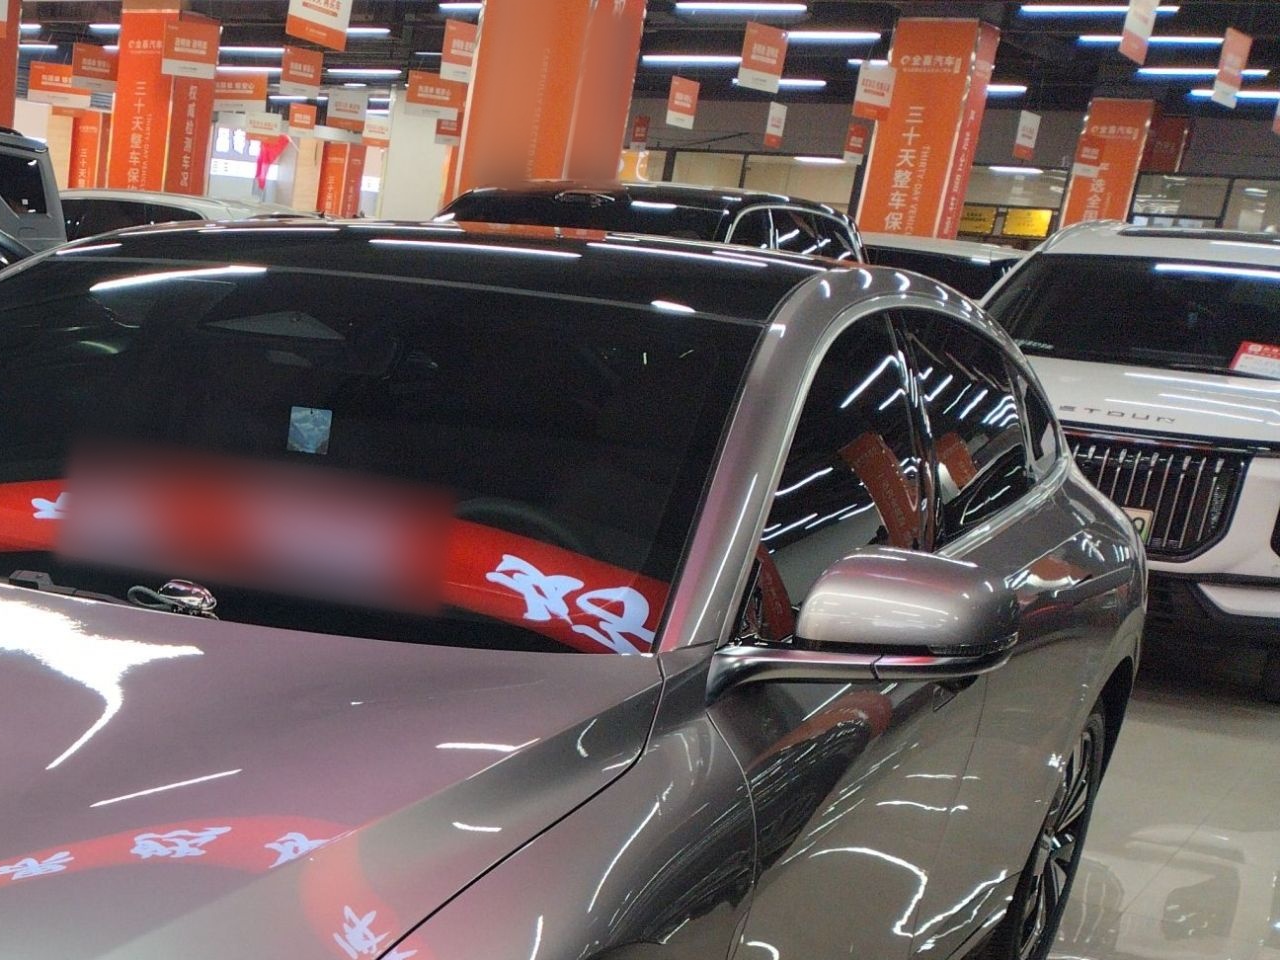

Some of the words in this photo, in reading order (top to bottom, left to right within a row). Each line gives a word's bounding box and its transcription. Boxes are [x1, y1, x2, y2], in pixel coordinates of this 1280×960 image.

[884, 106, 925, 231] 三十天整车保
[1058, 405, 1177, 424] ETOUR
